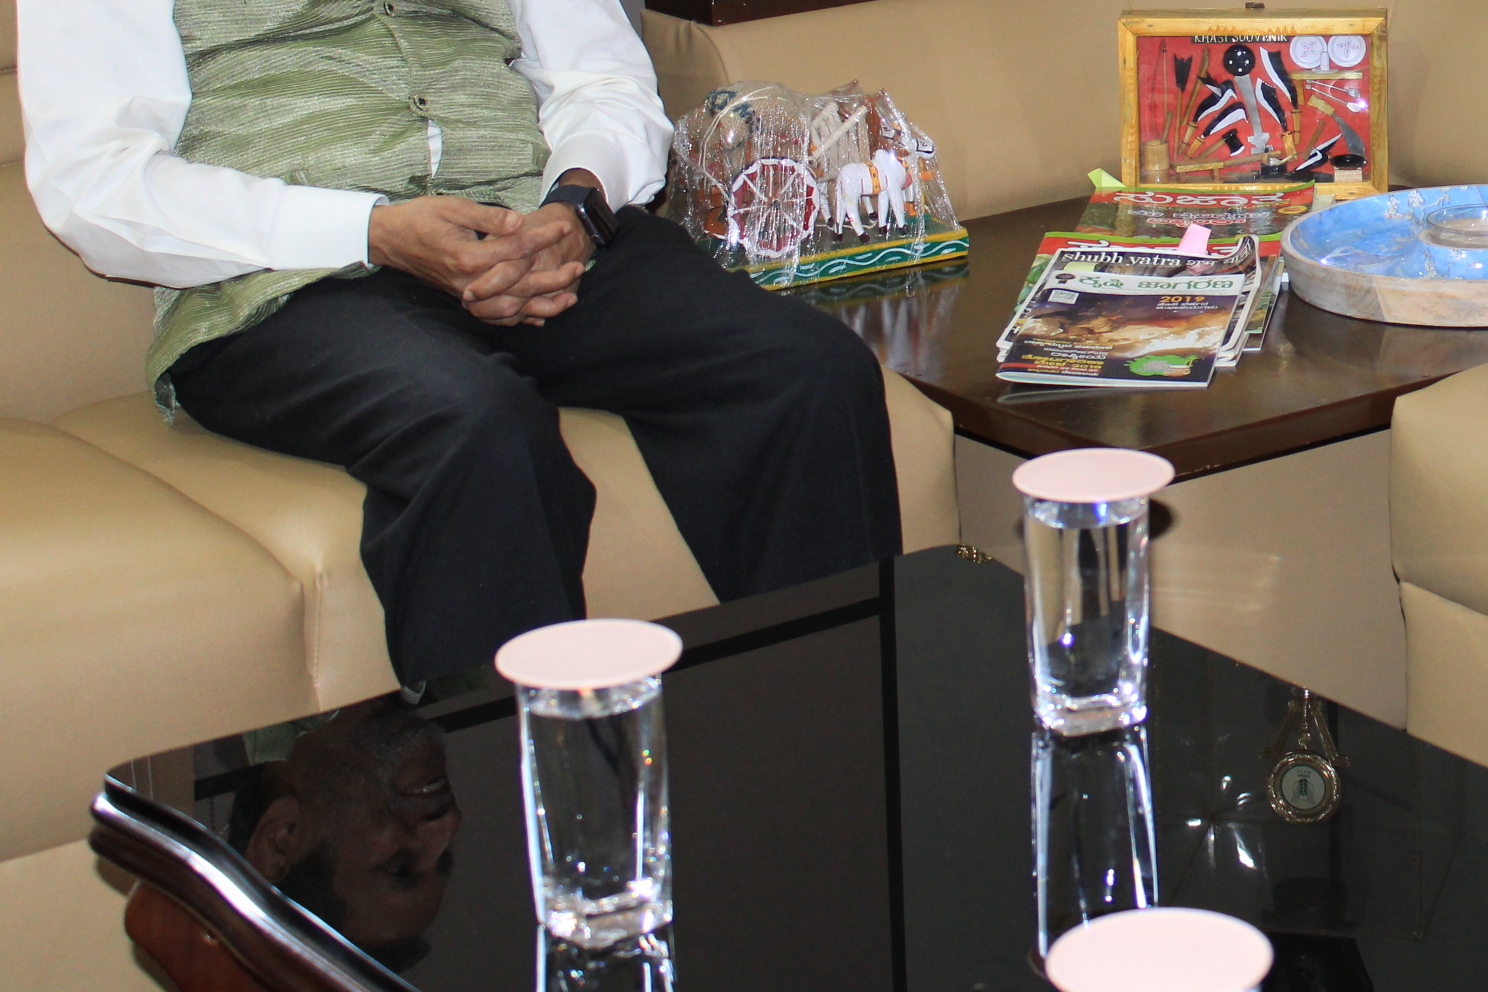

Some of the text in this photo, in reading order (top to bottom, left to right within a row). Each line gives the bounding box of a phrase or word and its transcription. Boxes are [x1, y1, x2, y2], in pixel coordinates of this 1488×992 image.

[1194, 34, 1287, 43] KHASI SOUVENIR
[1061, 252, 1181, 267] shubh yatra
[1138, 279, 1234, 290] ಜಾಗರಣ
